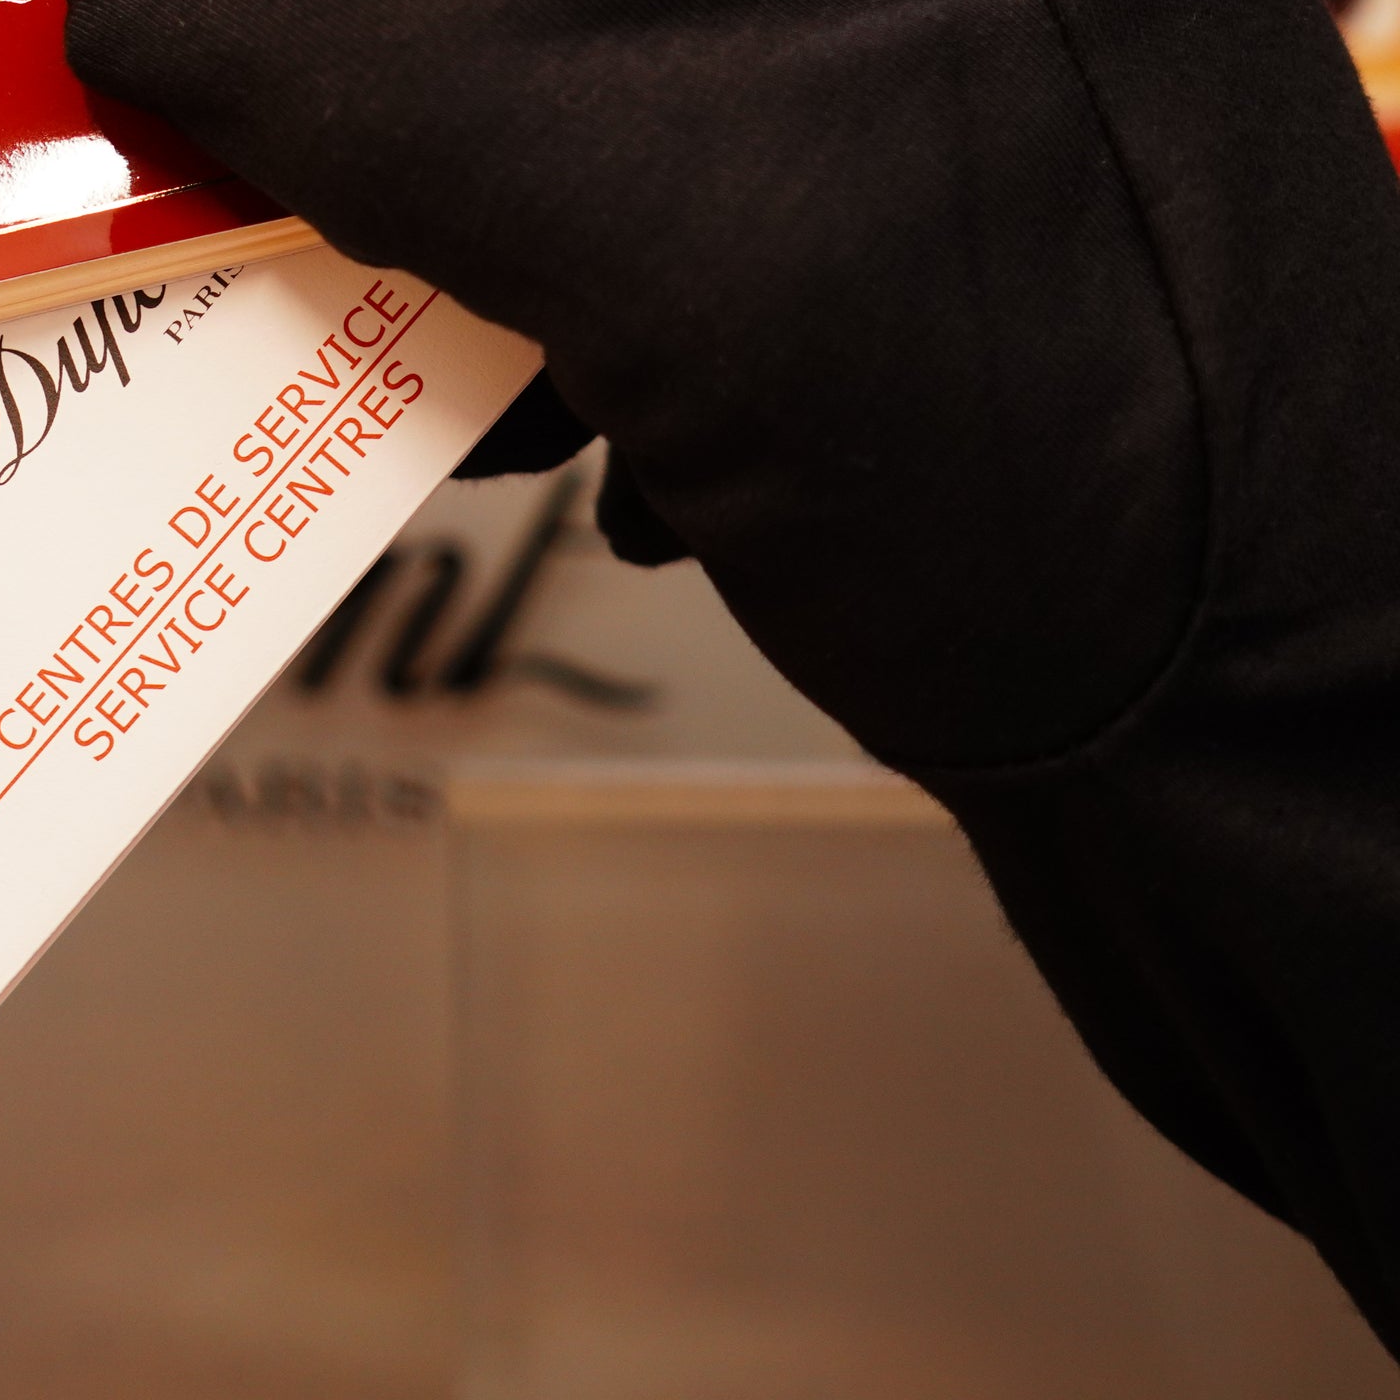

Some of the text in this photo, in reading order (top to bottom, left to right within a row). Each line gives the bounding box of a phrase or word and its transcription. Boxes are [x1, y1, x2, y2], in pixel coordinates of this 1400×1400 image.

[73, 359, 426, 763] SERVICE CENTRES
[167, 473, 241, 550] DE
[232, 279, 410, 479] SERVICE
